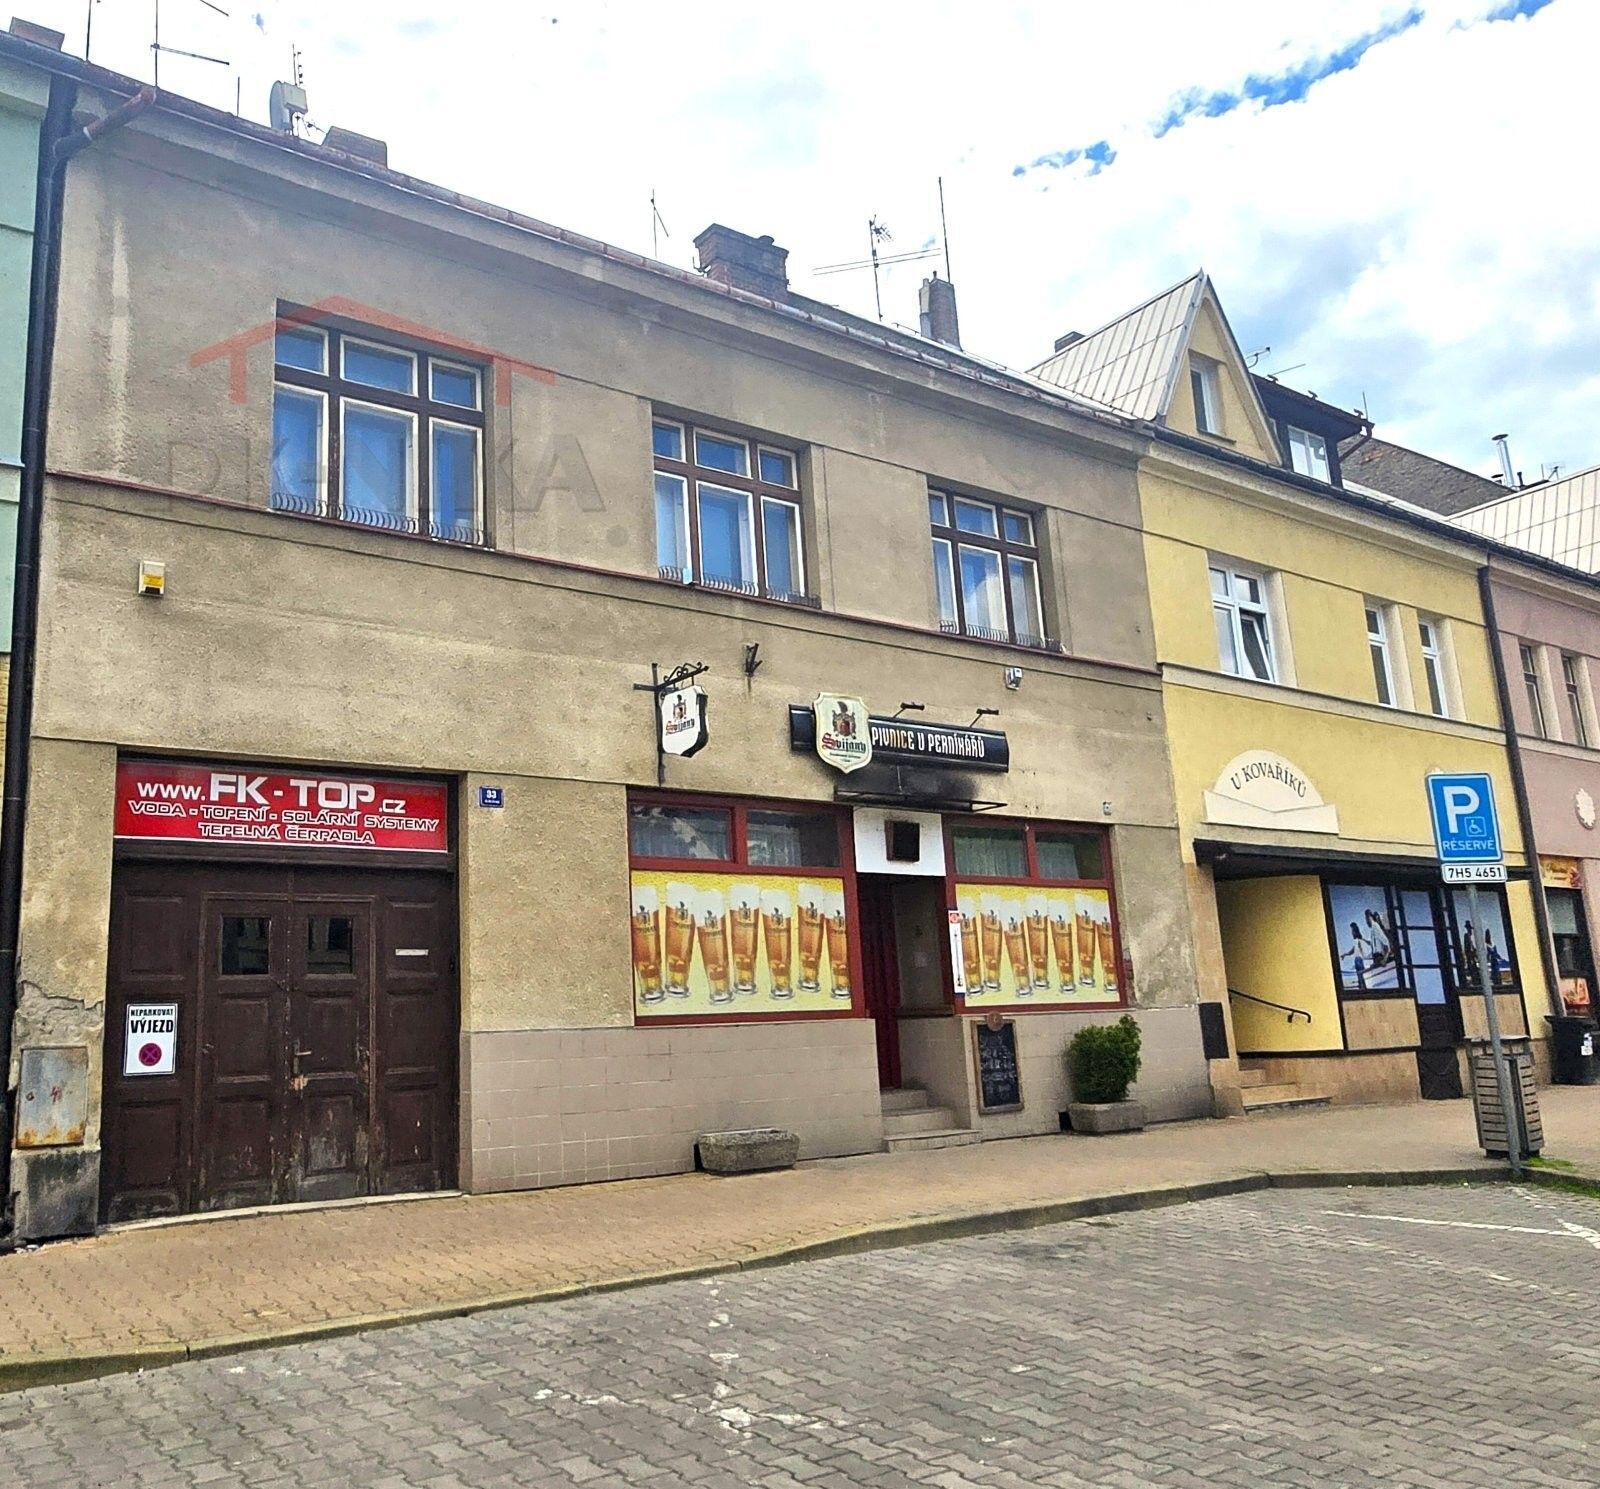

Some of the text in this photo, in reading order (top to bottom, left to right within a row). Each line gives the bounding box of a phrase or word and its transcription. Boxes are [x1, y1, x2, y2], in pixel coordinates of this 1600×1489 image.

[821, 732, 866, 754] Svijany
[871, 726, 985, 758] PIVNICE U PERNÍKÁŘŮ
[1230, 761, 1307, 798] U KOVAŘÍKŮ
[486, 789, 497, 799] 33
[128, 800, 186, 818] VODA
[200, 805, 271, 822] TOPENÍ
[282, 809, 361, 826] SOLÁRNÍ
[364, 815, 439, 832] SYSTEMY
[1442, 785, 1480, 834] P
[198, 821, 376, 845] TEPELNÁ ČERPADLA
[1448, 867, 1502, 879] 7H5 4651
[130, 1008, 174, 1017] NEPARKOVAT
[130, 1017, 174, 1033] VÝJEZD
